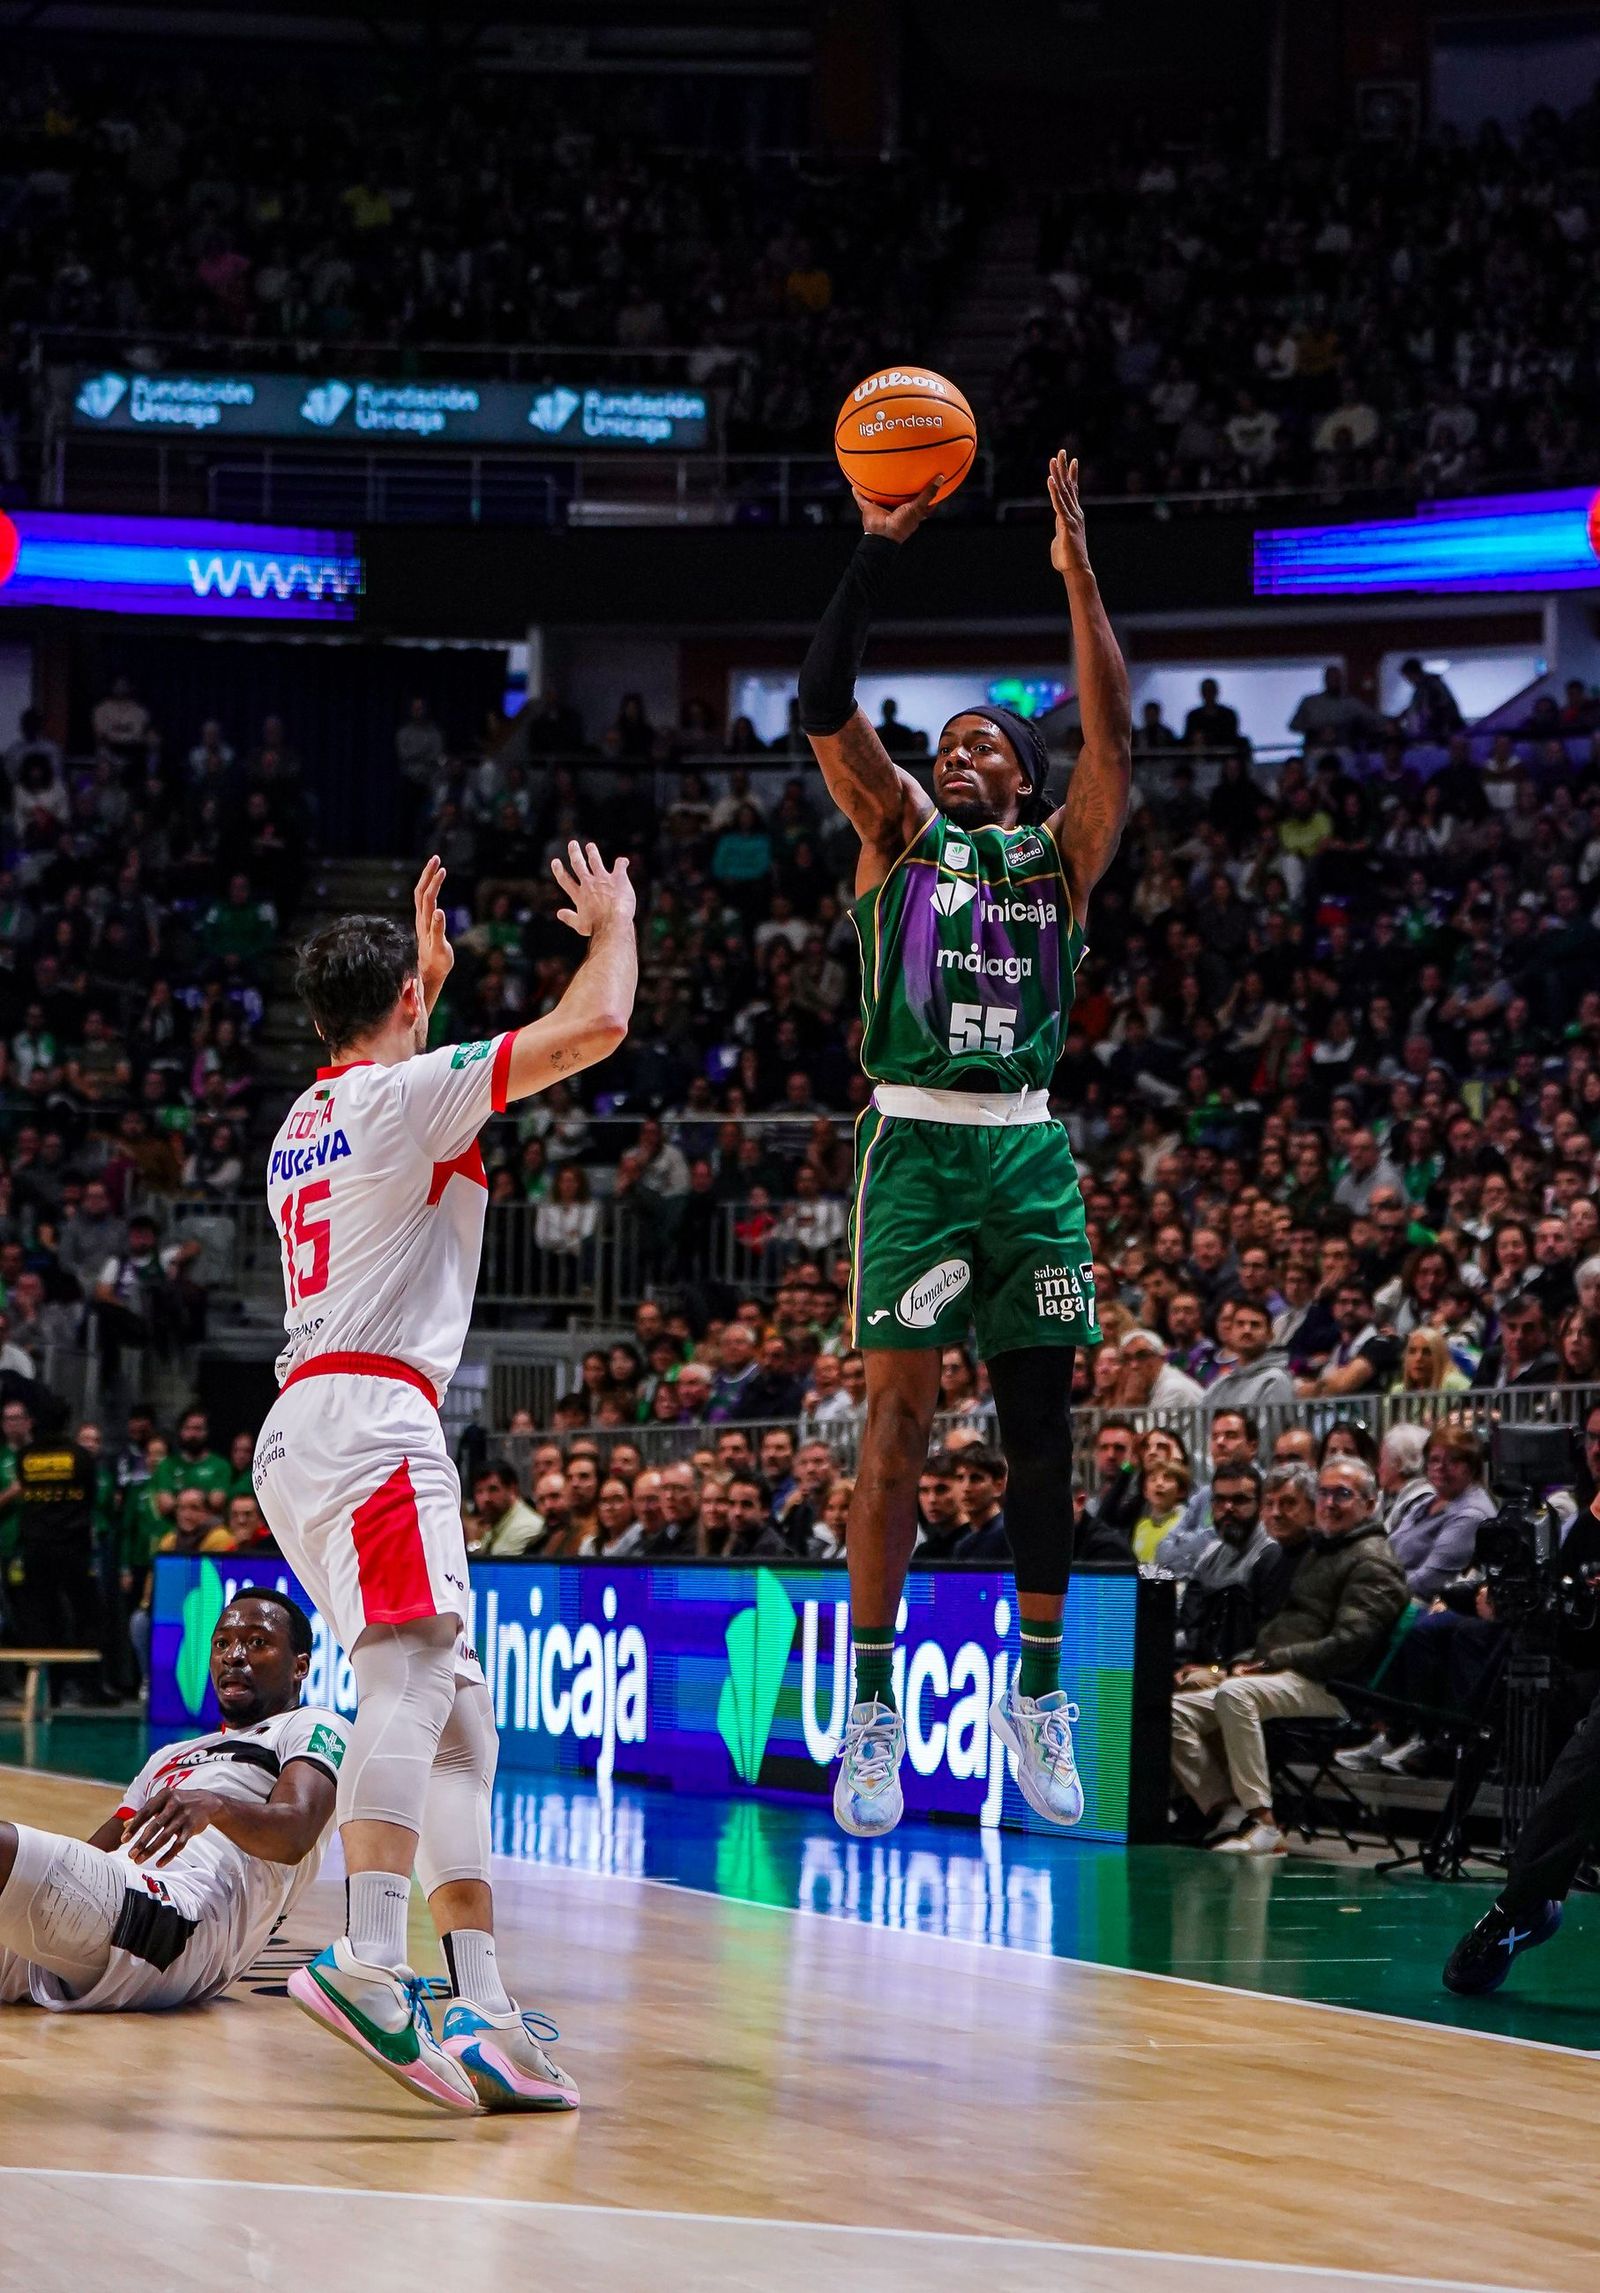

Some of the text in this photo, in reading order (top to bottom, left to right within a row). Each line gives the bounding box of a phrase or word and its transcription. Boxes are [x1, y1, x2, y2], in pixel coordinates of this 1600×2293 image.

[853, 371, 947, 402] Wilson
[859, 414, 943, 436] liga endesa
[949, 1002, 1018, 1058] 55
[269, 1128, 352, 1186] PULEVA
[280, 1178, 332, 1309] 15
[906, 1265, 967, 1321] famadesa
[1034, 1264, 1069, 1280] sabor
[1036, 1293, 1086, 1322] laga
